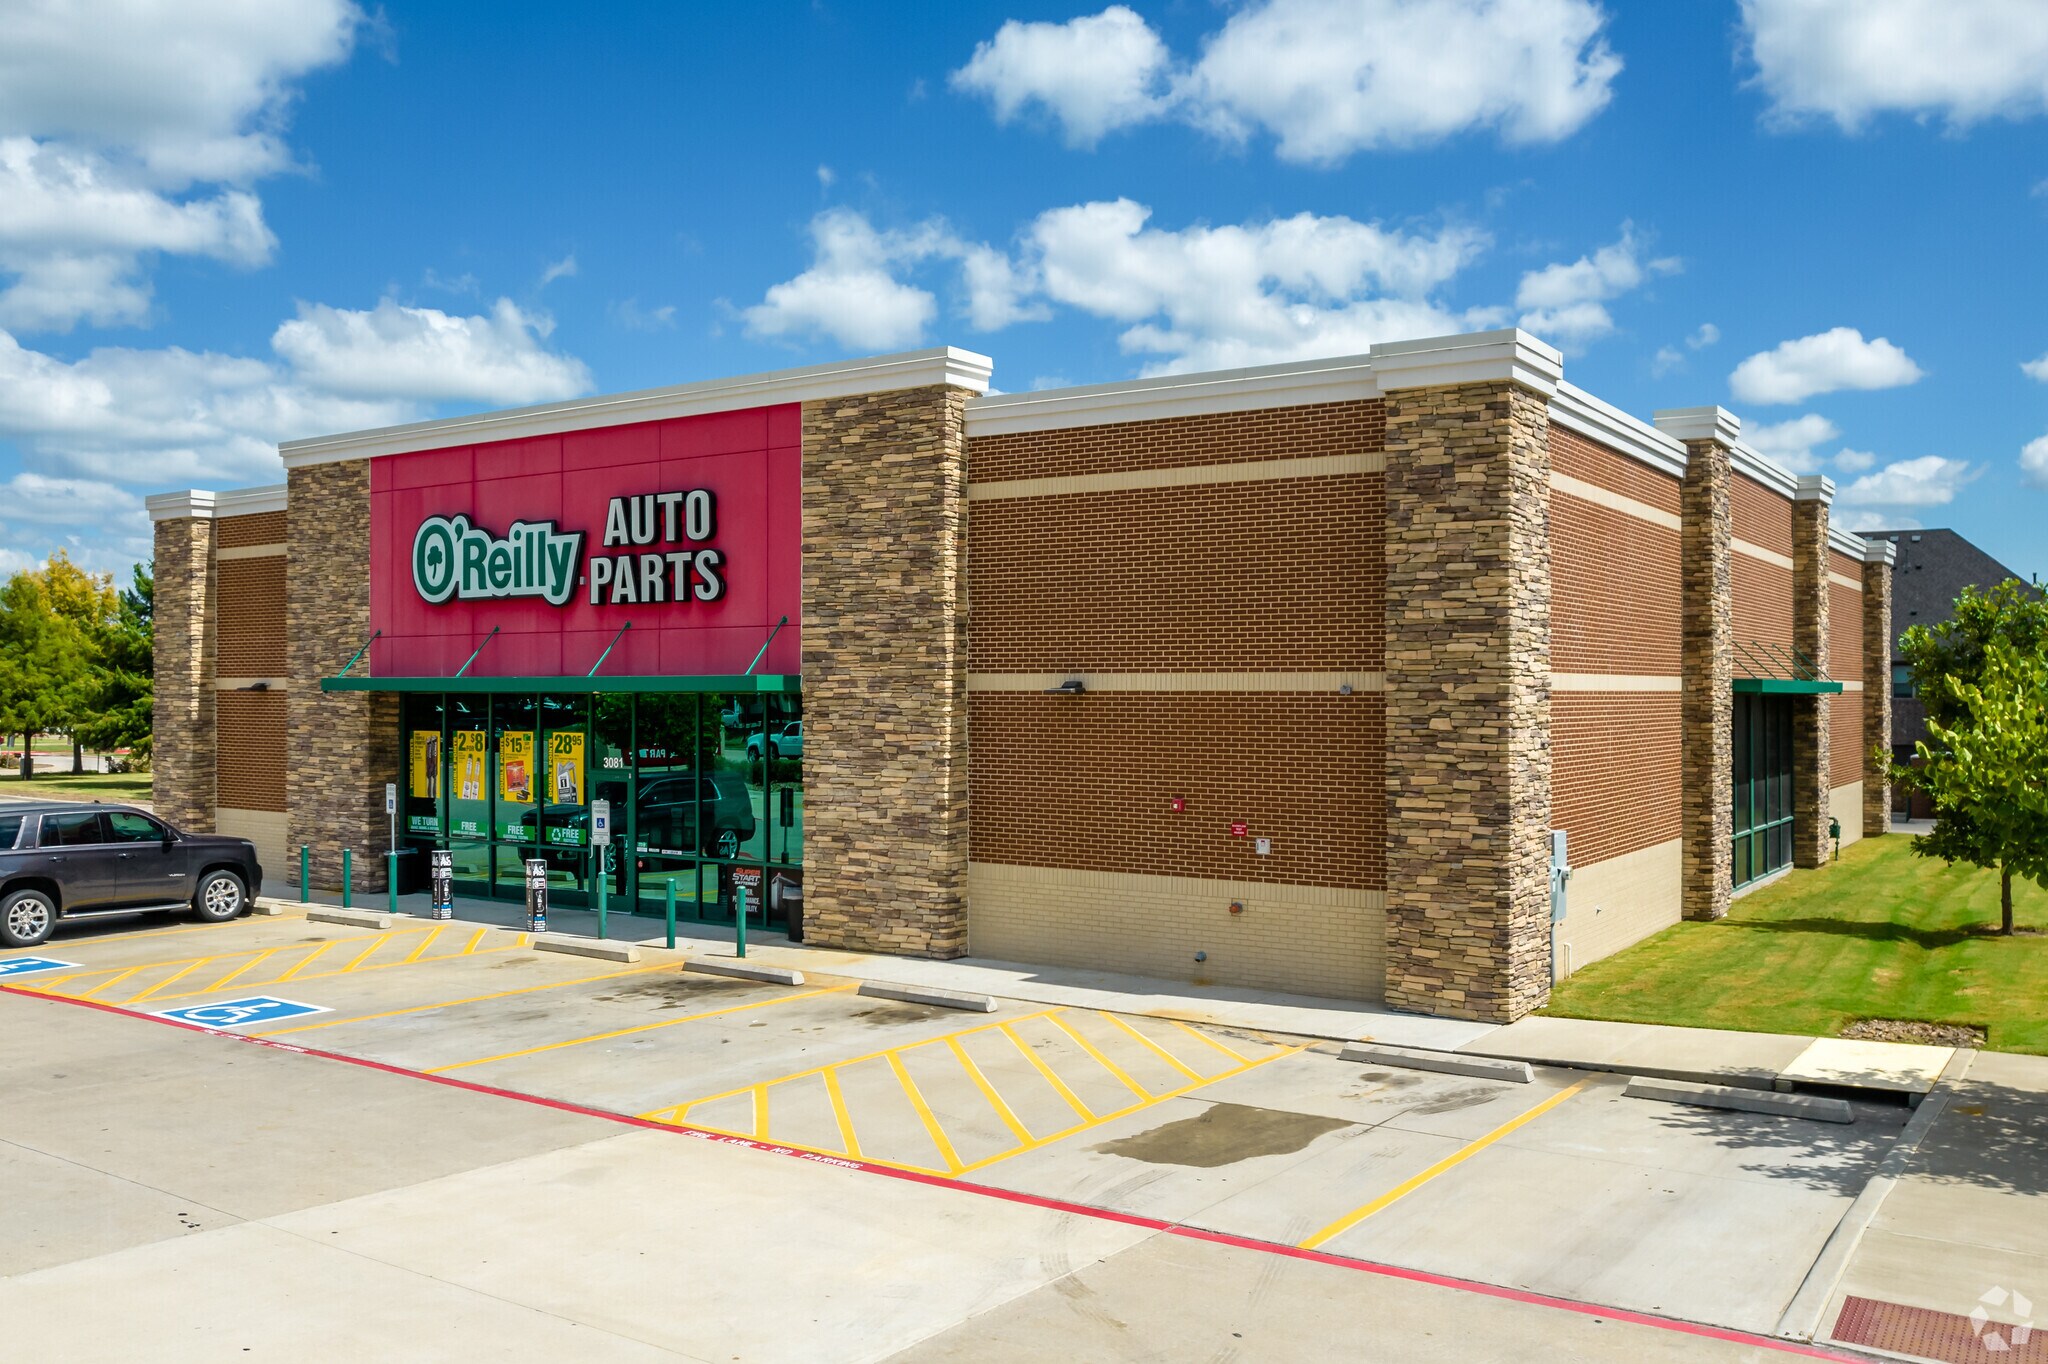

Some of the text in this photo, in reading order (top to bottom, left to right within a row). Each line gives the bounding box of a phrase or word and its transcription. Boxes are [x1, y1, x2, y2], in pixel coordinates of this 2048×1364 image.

[603, 489, 712, 547] AUTO
[416, 521, 574, 597] O'Reilly
[590, 549, 720, 605] PARTS
[506, 738, 522, 752] $15
[603, 757, 623, 768] 3081
[412, 816, 438, 826] WE TURN
[461, 822, 477, 831] FREE
[508, 825, 524, 835] FREE
[562, 828, 579, 838] FREE
[732, 873, 761, 882] START
[682, 1130, 714, 1140] FIRE
[717, 1137, 757, 1147] LANE
[770, 1147, 793, 1156] NO
[800, 1153, 863, 1169] PARKING
